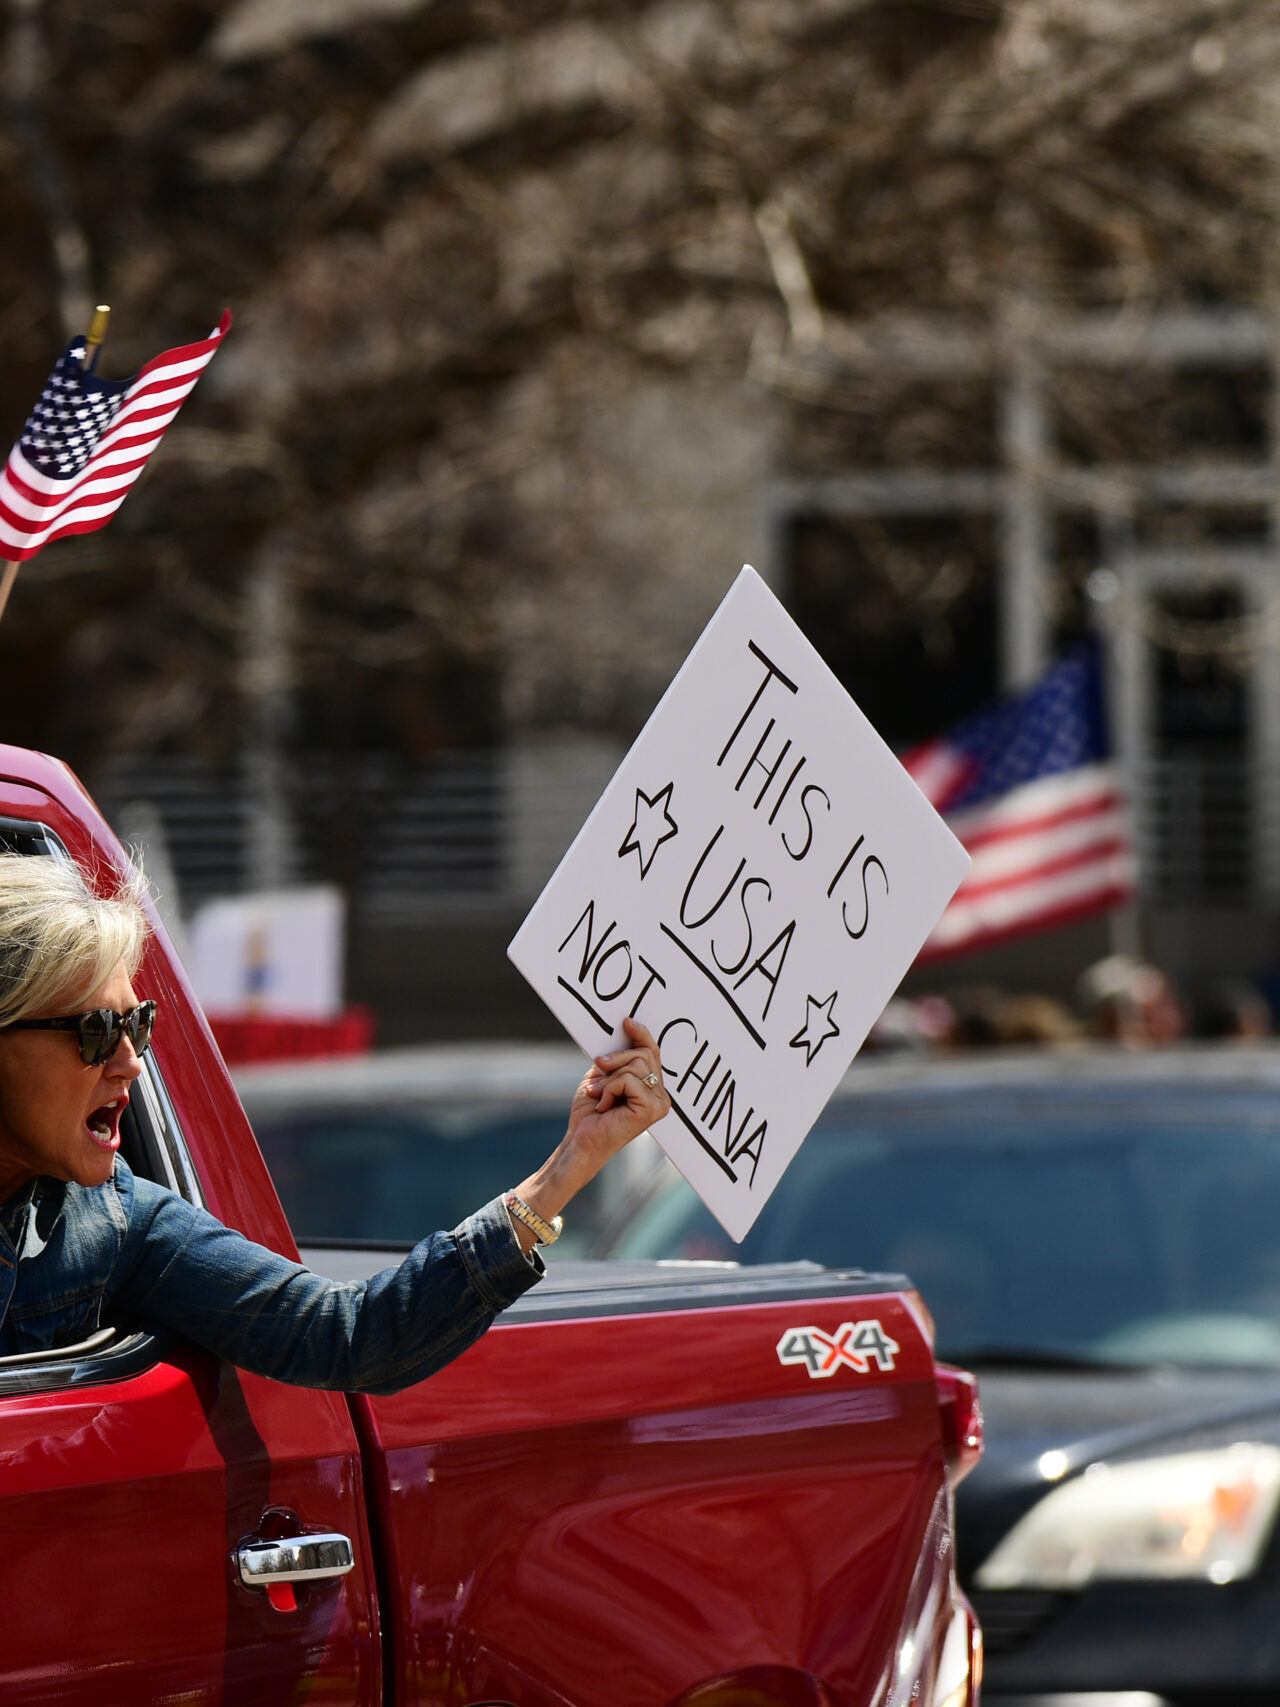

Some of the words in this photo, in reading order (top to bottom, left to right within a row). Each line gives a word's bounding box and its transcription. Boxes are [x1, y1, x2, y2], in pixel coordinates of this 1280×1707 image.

[679, 825, 796, 1021] USA
[716, 639, 830, 861] THIS
[827, 834, 889, 940] IS
[558, 900, 666, 1019] NOT
[658, 1017, 767, 1190] CHINA
